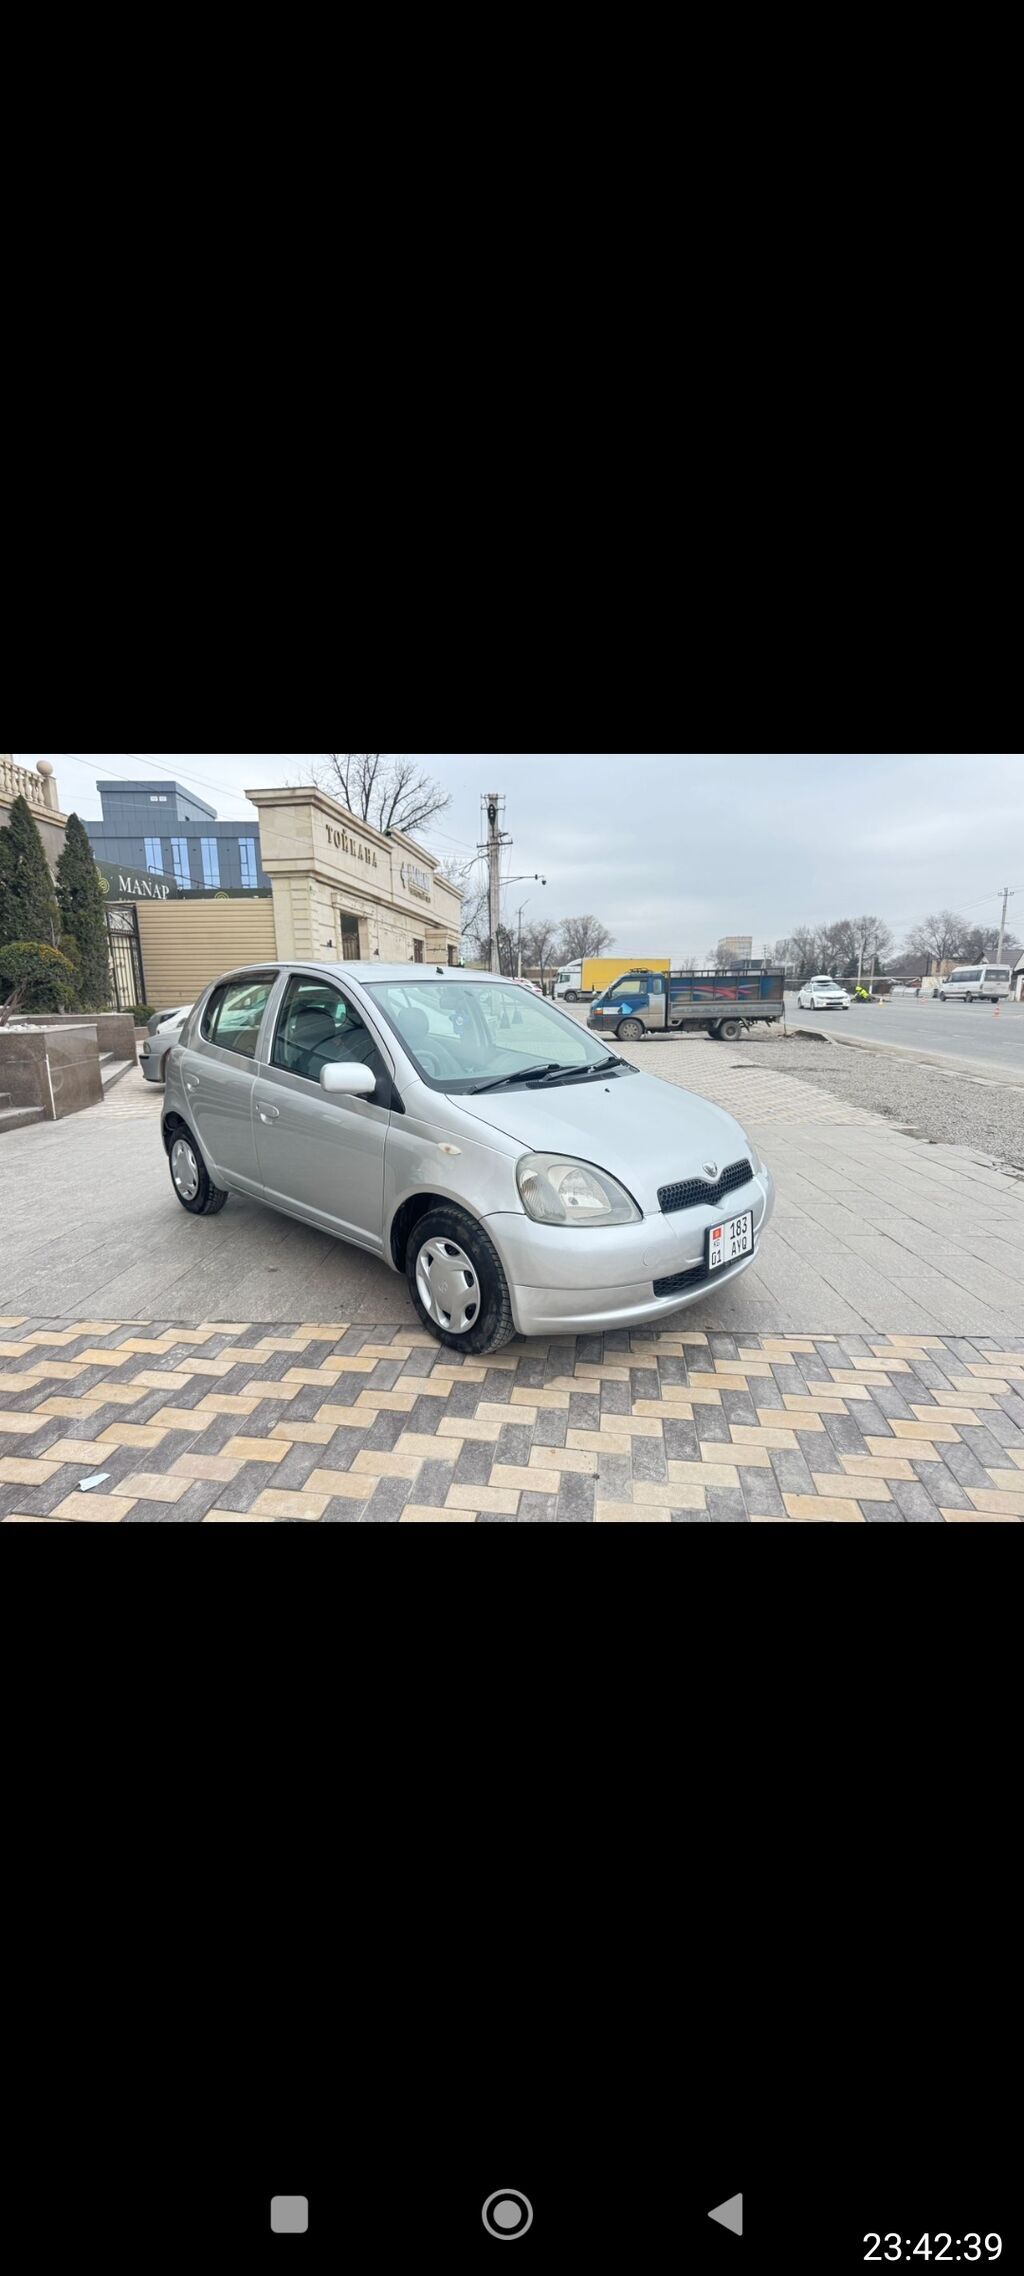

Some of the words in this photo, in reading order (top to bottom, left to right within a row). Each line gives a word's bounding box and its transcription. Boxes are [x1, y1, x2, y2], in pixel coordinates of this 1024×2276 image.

[730, 1217, 747, 1239] 183
[732, 1236, 747, 1256] AYQ
[711, 1250, 722, 1266] 01
